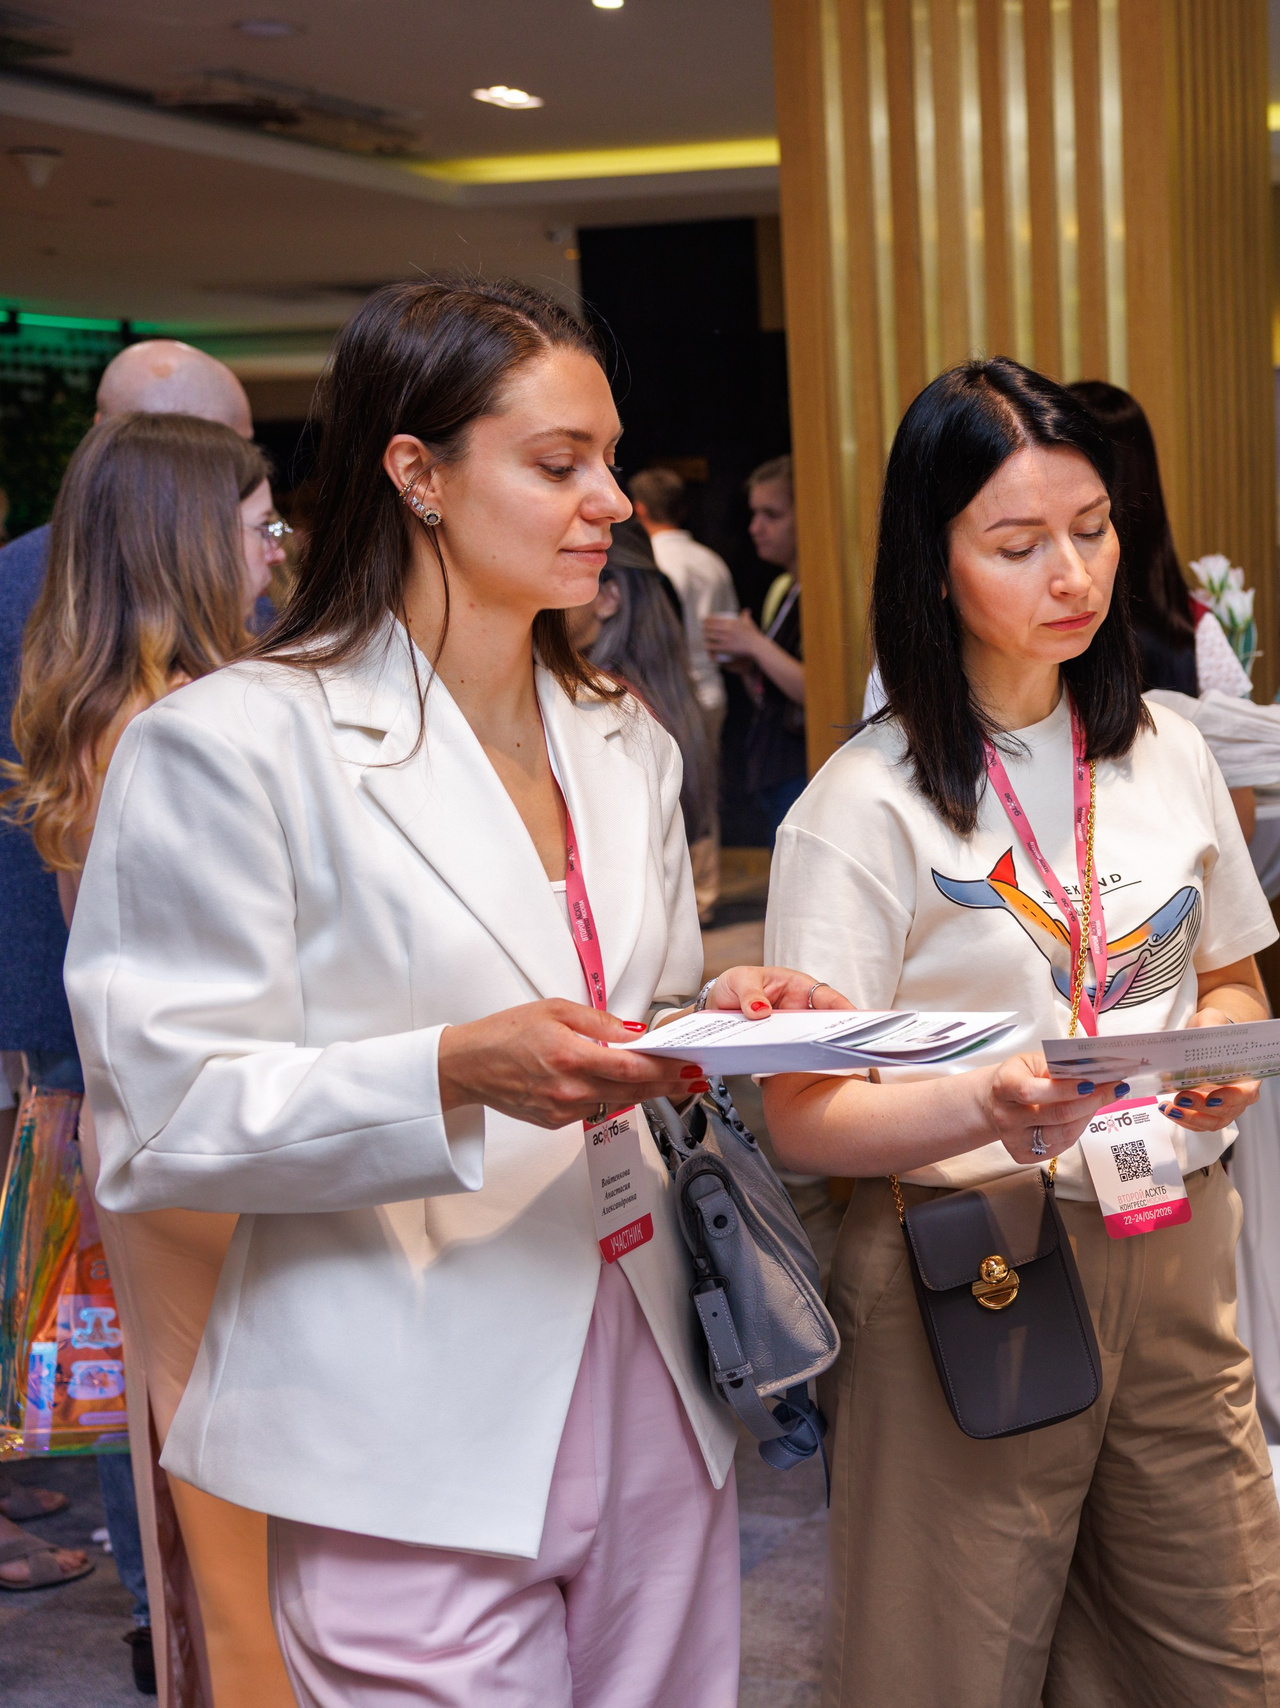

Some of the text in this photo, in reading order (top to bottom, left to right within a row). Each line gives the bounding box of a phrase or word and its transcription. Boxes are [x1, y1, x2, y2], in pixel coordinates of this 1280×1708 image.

[602, 1168, 630, 1188] Войтенкова
[604, 1182, 630, 1200] Анастасия
[1145, 1186, 1166, 1198] АСХТБ
[602, 1193, 637, 1216] Александровна
[1120, 1200, 1147, 1211] КОНГРЕСС
[1124, 1206, 1172, 1225] 22-24/05/2026
[610, 1222, 643, 1255] УЧАСТНИК
